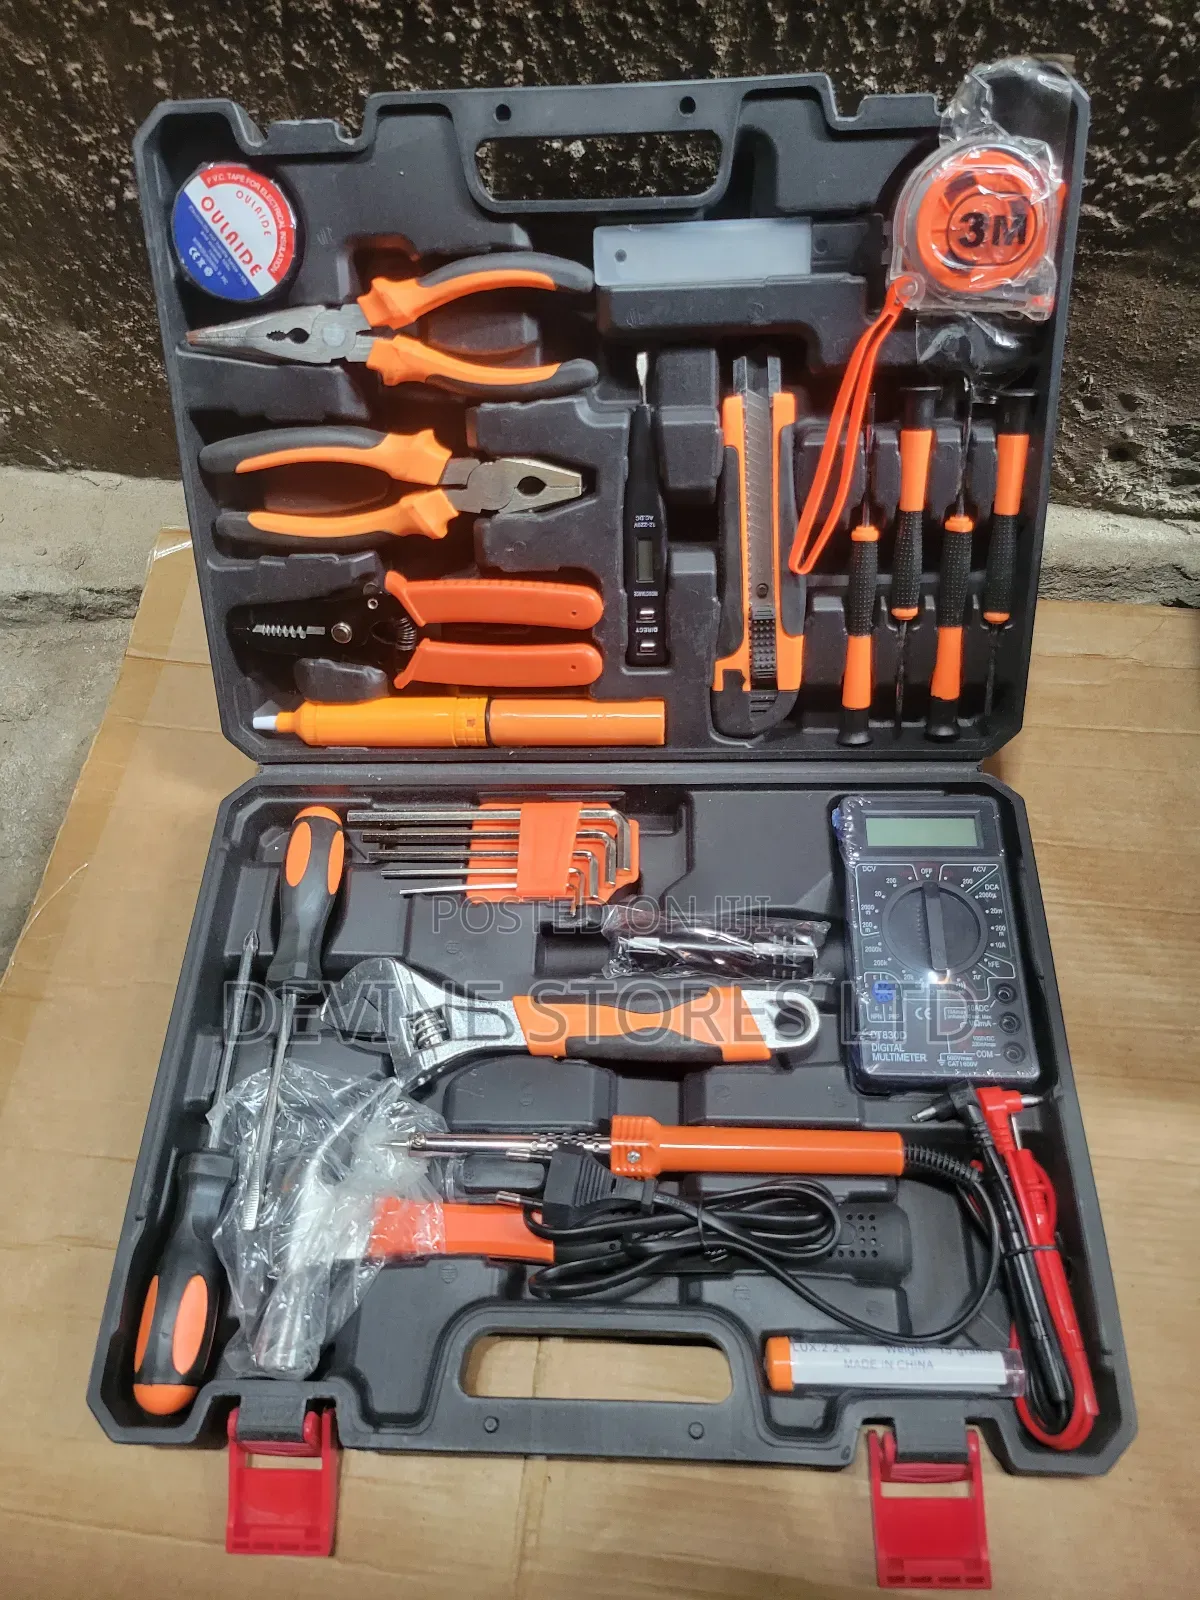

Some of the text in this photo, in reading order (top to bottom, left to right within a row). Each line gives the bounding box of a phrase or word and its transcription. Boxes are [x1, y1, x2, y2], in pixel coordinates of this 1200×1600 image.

[226, 172, 246, 183] TAPE
[245, 177, 262, 192] FOR
[235, 190, 272, 237] OULAIDE
[958, 212, 1028, 248] 3M
[201, 196, 264, 278] OULAIDE
[636, 626, 659, 634] DIRECT
[871, 1043, 906, 1053] DIGITAL
[872, 1052, 928, 1063] MULTIMETER
[975, 1050, 994, 1058] COM
[843, 1359, 934, 1369] MADE IN CHINA
